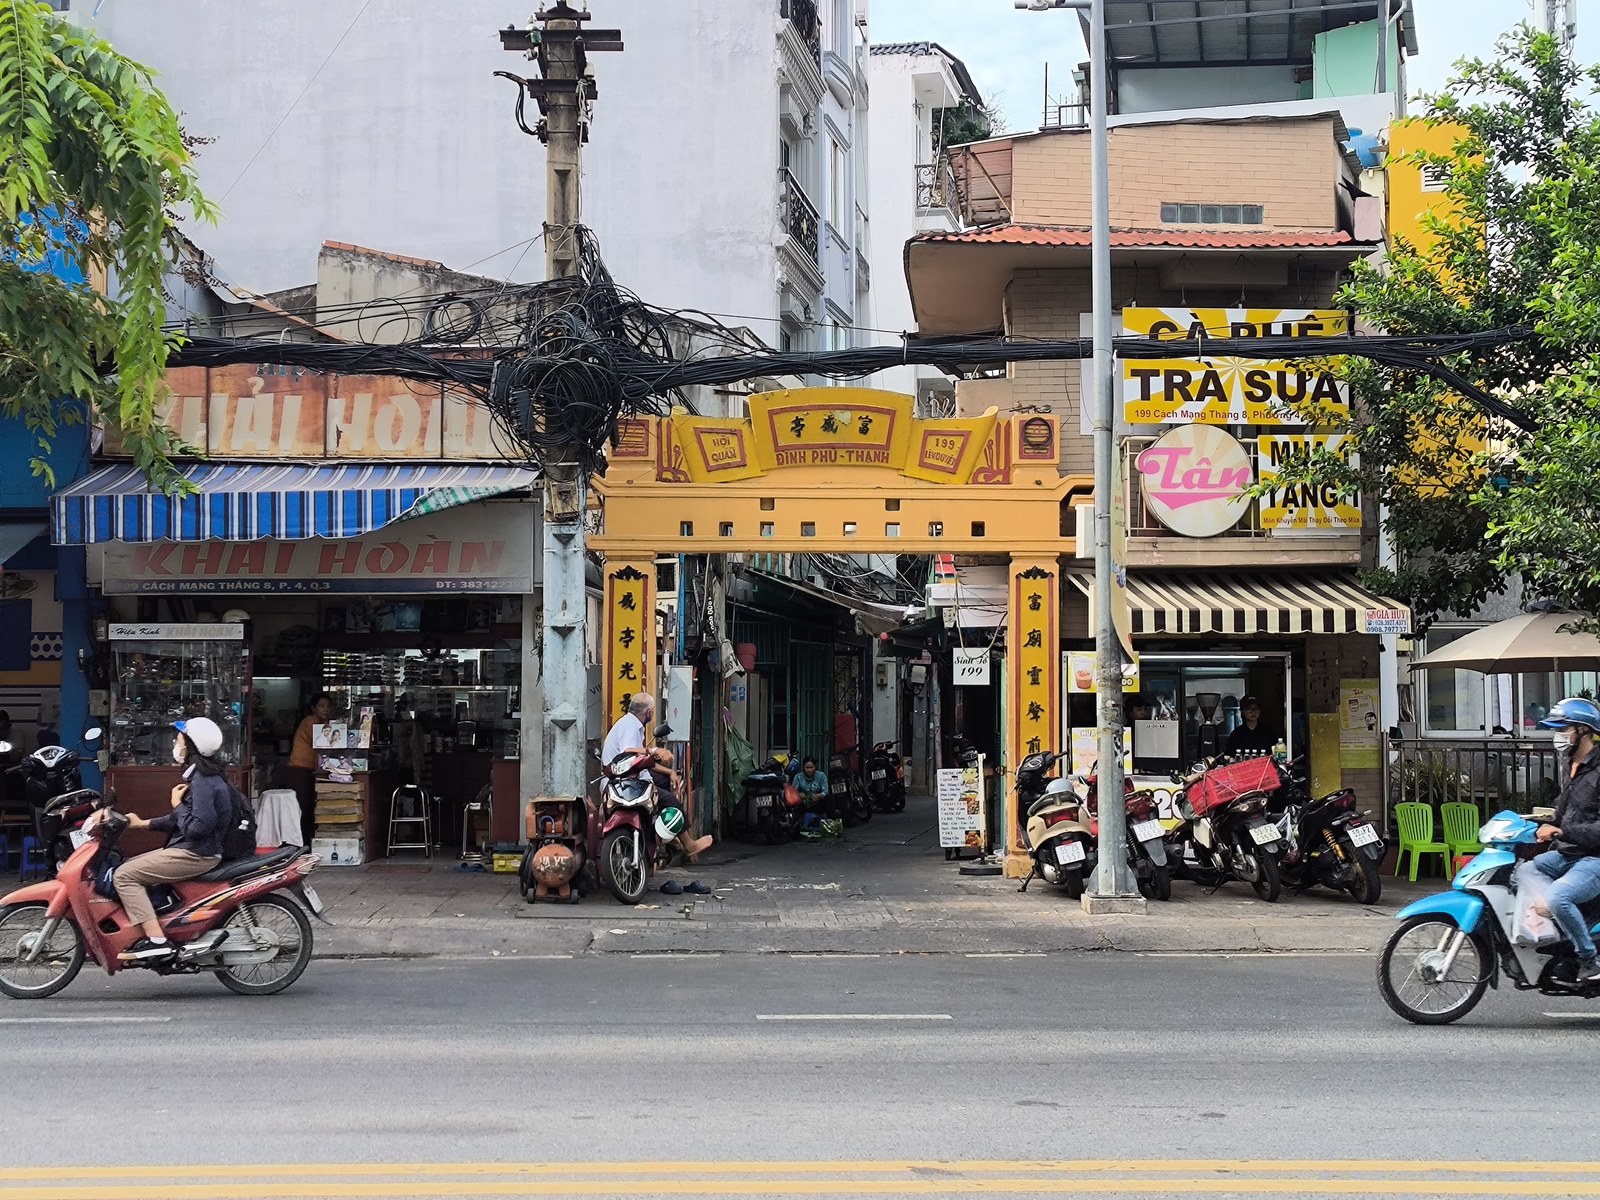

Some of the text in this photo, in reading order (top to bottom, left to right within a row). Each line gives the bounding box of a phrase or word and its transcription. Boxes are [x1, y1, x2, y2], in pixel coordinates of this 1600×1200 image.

[1131, 361, 1229, 402] TRÀ
[1134, 410, 1151, 418] 199
[1153, 408, 1178, 418] Cách
[1180, 410, 1206, 420] Mạng
[1209, 409, 1239, 420] Tháng
[1241, 411, 1250, 419] 8,
[935, 437, 955, 450] 199
[1138, 446, 1251, 490] Tân
[1309, 516, 1322, 524] Thay
[317, 534, 505, 575] HOÀN
[142, 580, 175, 590] CÁCH
[179, 582, 215, 594] MẠNG
[218, 580, 261, 590] THÁNG
[263, 581, 276, 591] 8,
[279, 581, 291, 590] P.
[294, 581, 308, 591] 4,
[310, 581, 331, 591] Q.3
[436, 581, 456, 589] ĐT:
[1376, 610, 1406, 619] GIA HUY
[960, 666, 983, 677] 199
